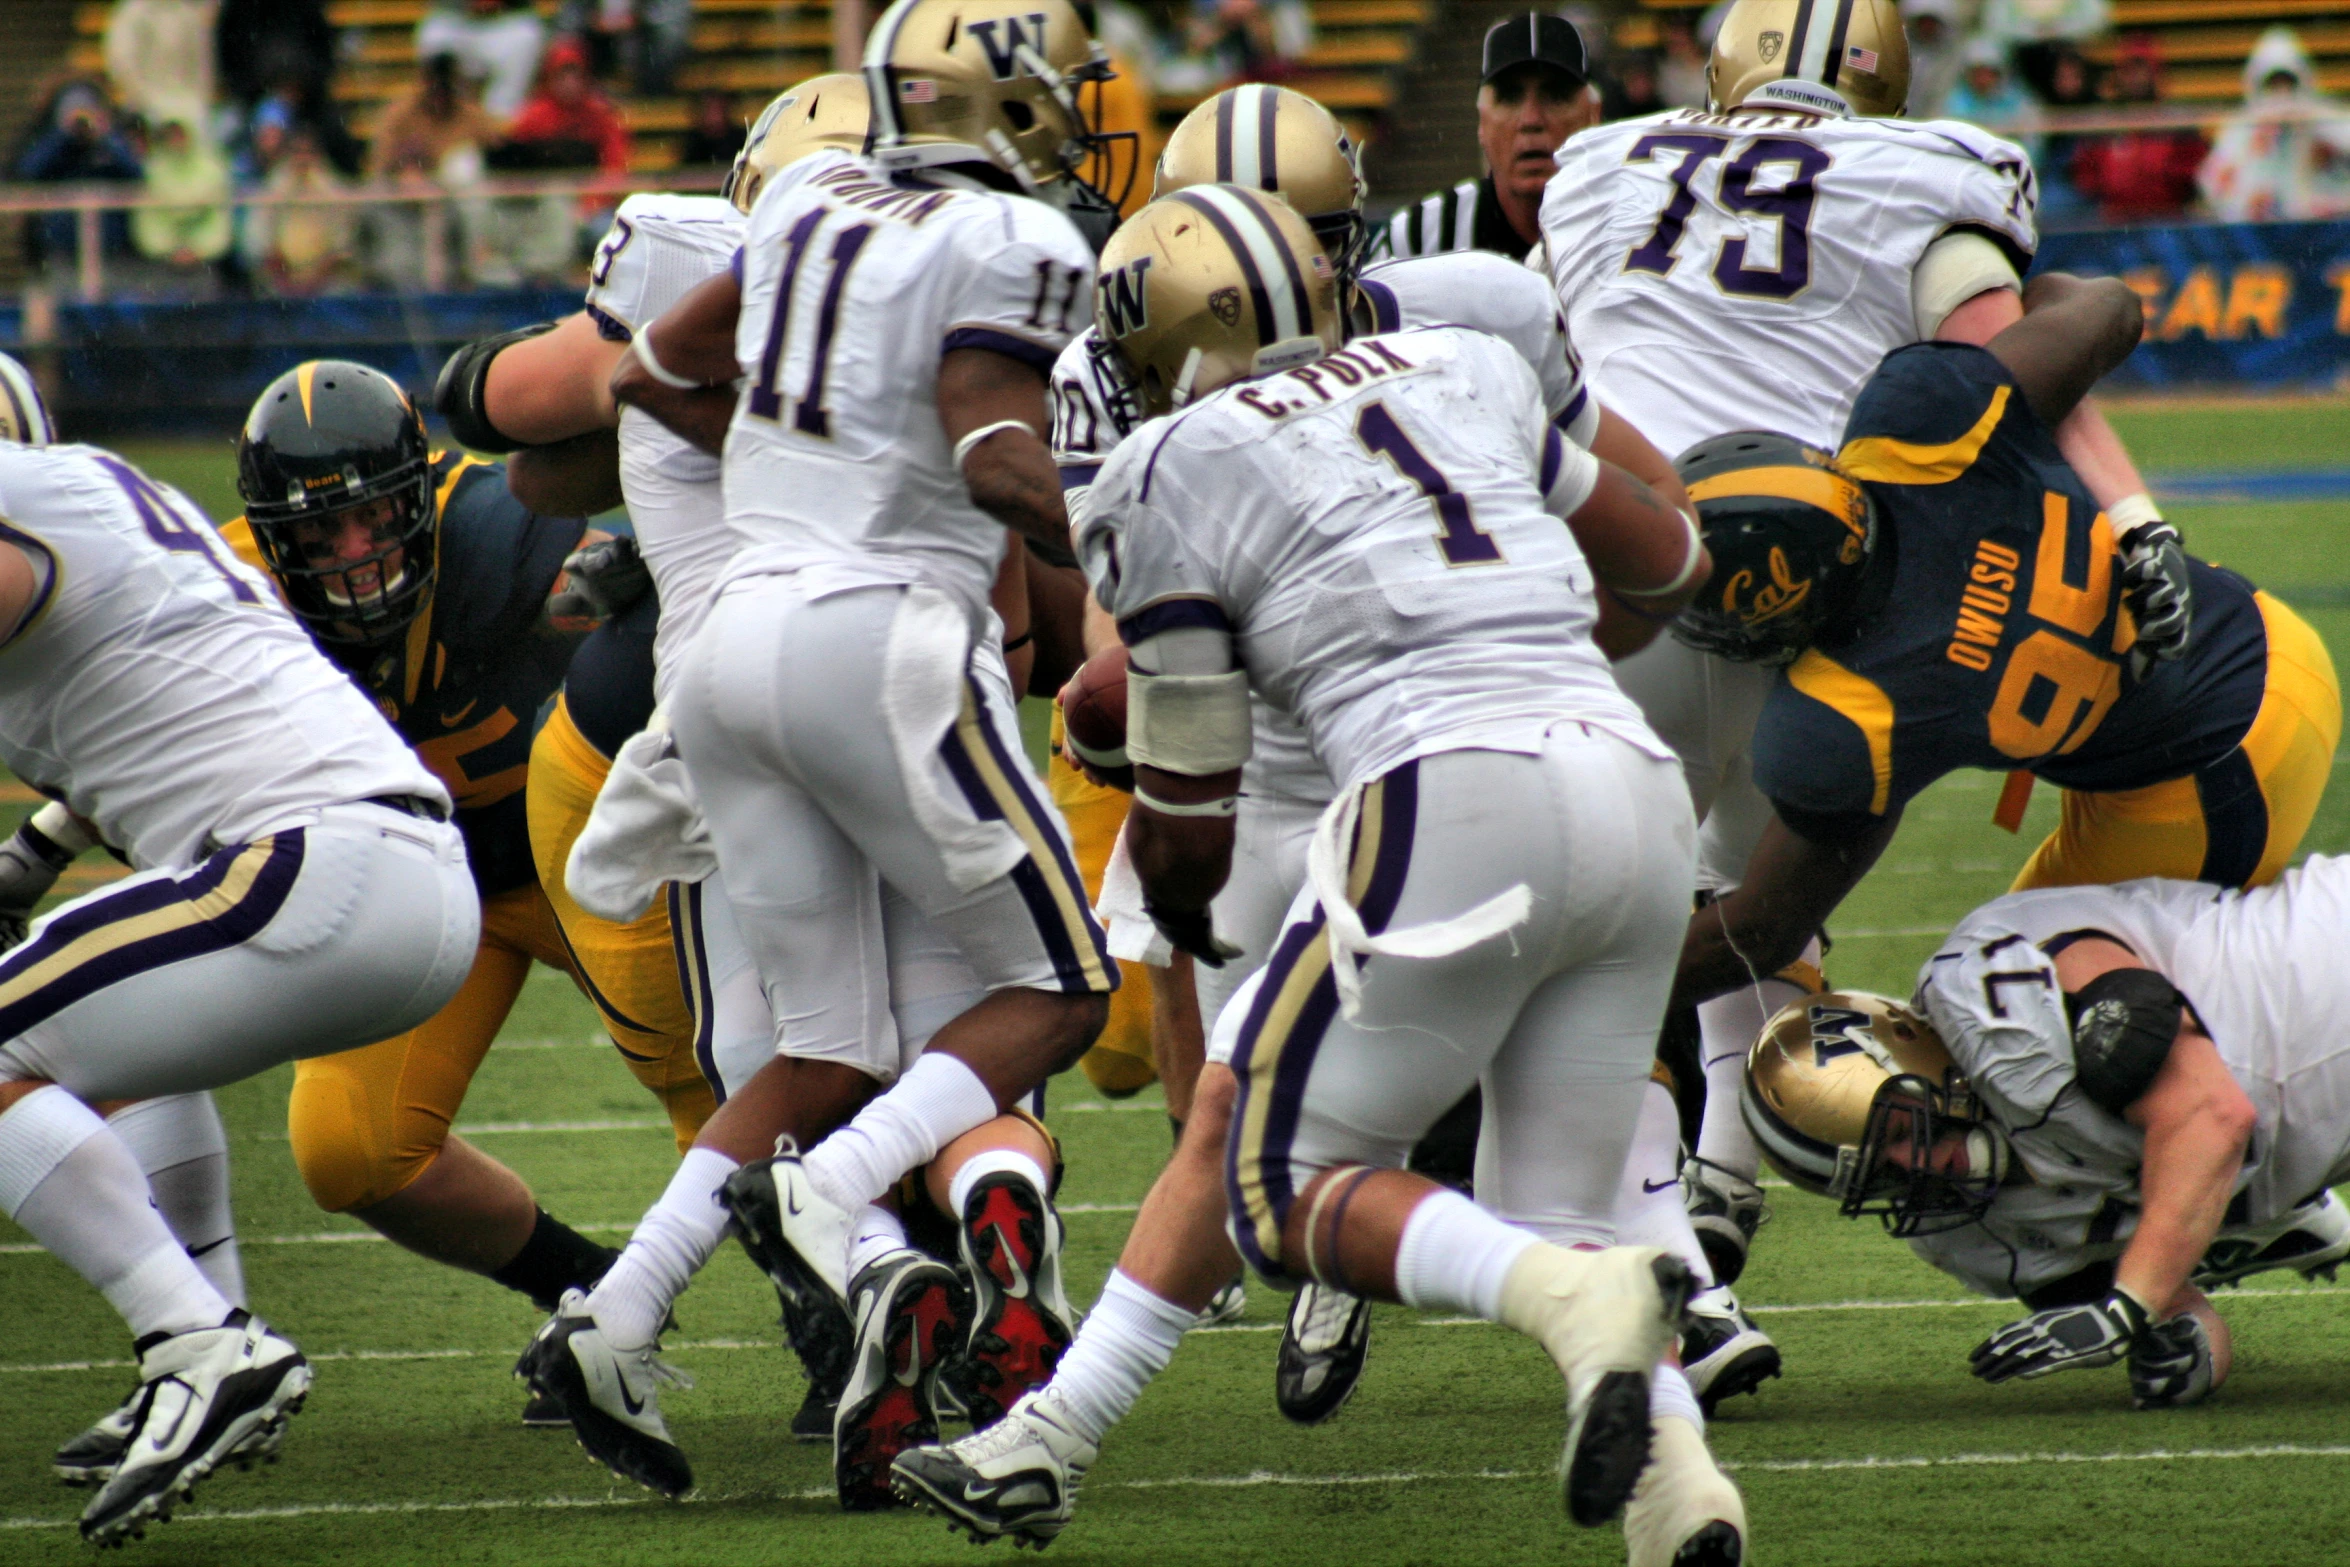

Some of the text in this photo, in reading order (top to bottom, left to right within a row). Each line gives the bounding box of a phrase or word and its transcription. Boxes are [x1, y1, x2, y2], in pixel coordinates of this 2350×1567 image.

[967, 12, 1047, 82] W
[1765, 85, 1847, 113] WASHINGTON
[1623, 133, 1836, 303] 79
[748, 204, 876, 439] 11
[1025, 258, 1084, 334] 11
[1097, 256, 1153, 340] W
[90, 454, 280, 608] 4
[1352, 396, 1507, 569] 1
[1722, 544, 1812, 627] Cal
[1945, 539, 2020, 672] OWUSU
[1986, 489, 2138, 760] 95
